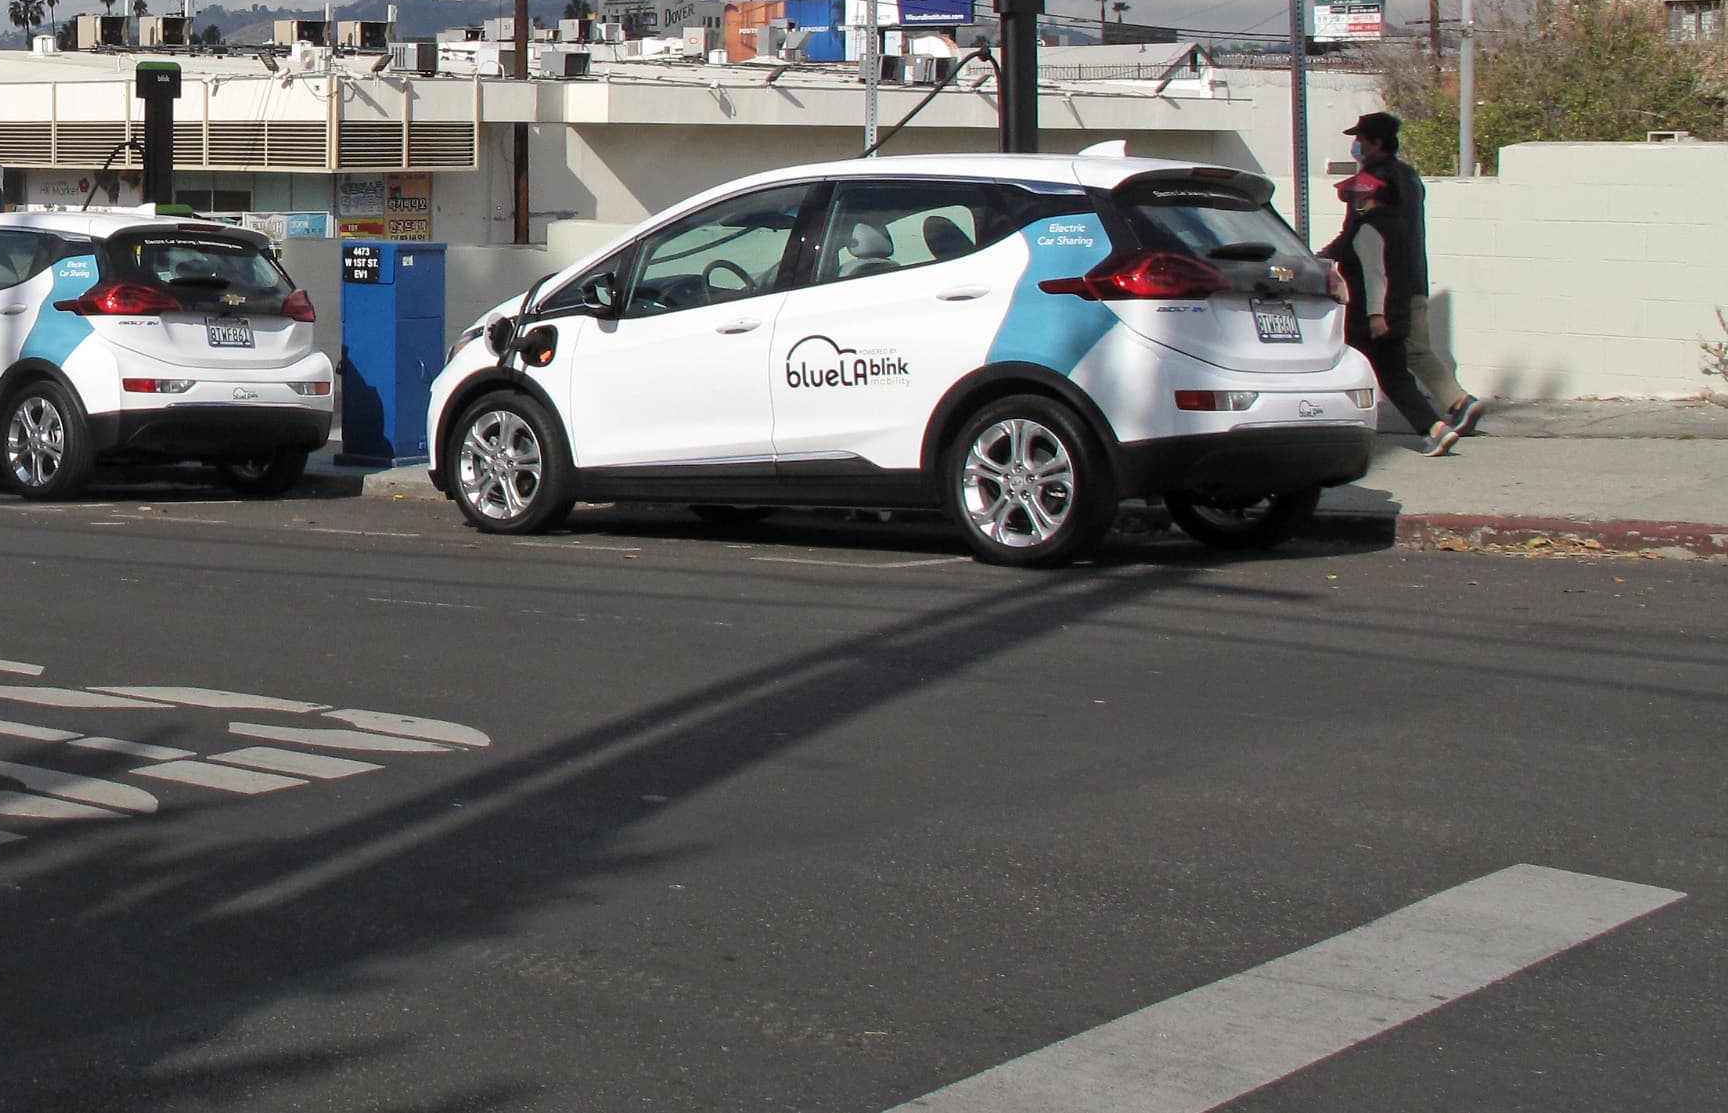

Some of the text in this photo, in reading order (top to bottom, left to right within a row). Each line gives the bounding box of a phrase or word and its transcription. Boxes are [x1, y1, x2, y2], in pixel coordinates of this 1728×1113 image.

[665, 3, 696, 27] DOVER
[1048, 223, 1087, 233] Electric
[1036, 235, 1094, 248] Car Sharing
[352, 247, 370, 256] 4473
[66, 261, 89, 269] Electric
[344, 258, 379, 268] W 1ST ST.
[59, 270, 90, 279] Car Sharing
[353, 269, 368, 279] EV1
[210, 327, 251, 343] 8TWF861
[858, 348, 887, 356] POWERED
[786, 357, 910, 388] blueLA blink
[870, 376, 911, 387] mobility
